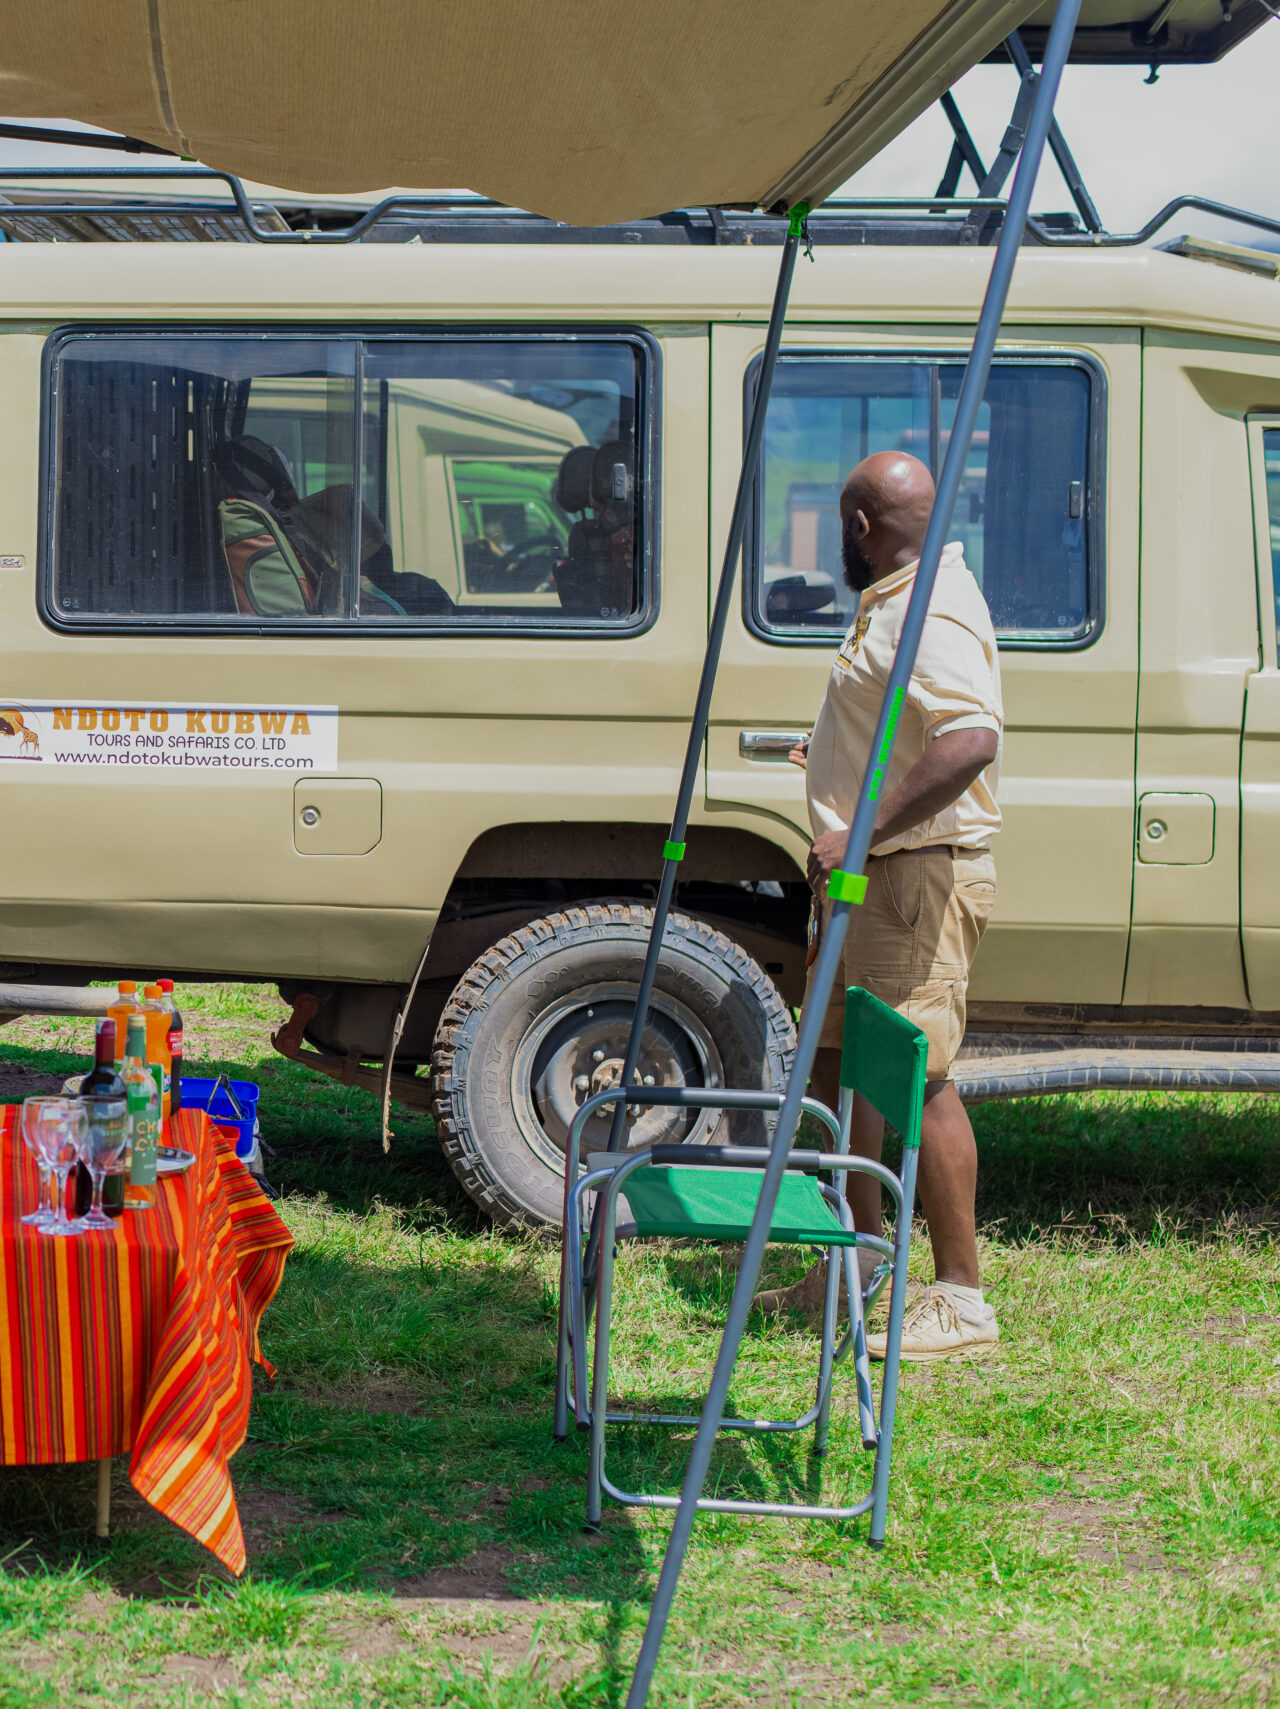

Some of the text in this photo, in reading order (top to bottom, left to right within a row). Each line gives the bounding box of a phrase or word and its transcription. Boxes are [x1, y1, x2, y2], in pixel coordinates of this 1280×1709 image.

[52, 708, 311, 735] NDOTO KUBWA
[878, 687, 904, 764] IRONMAN
[87, 733, 286, 751] TOURS AND SAFARIS CO. LTD
[54, 749, 314, 769] www.ndotokubwatours.com
